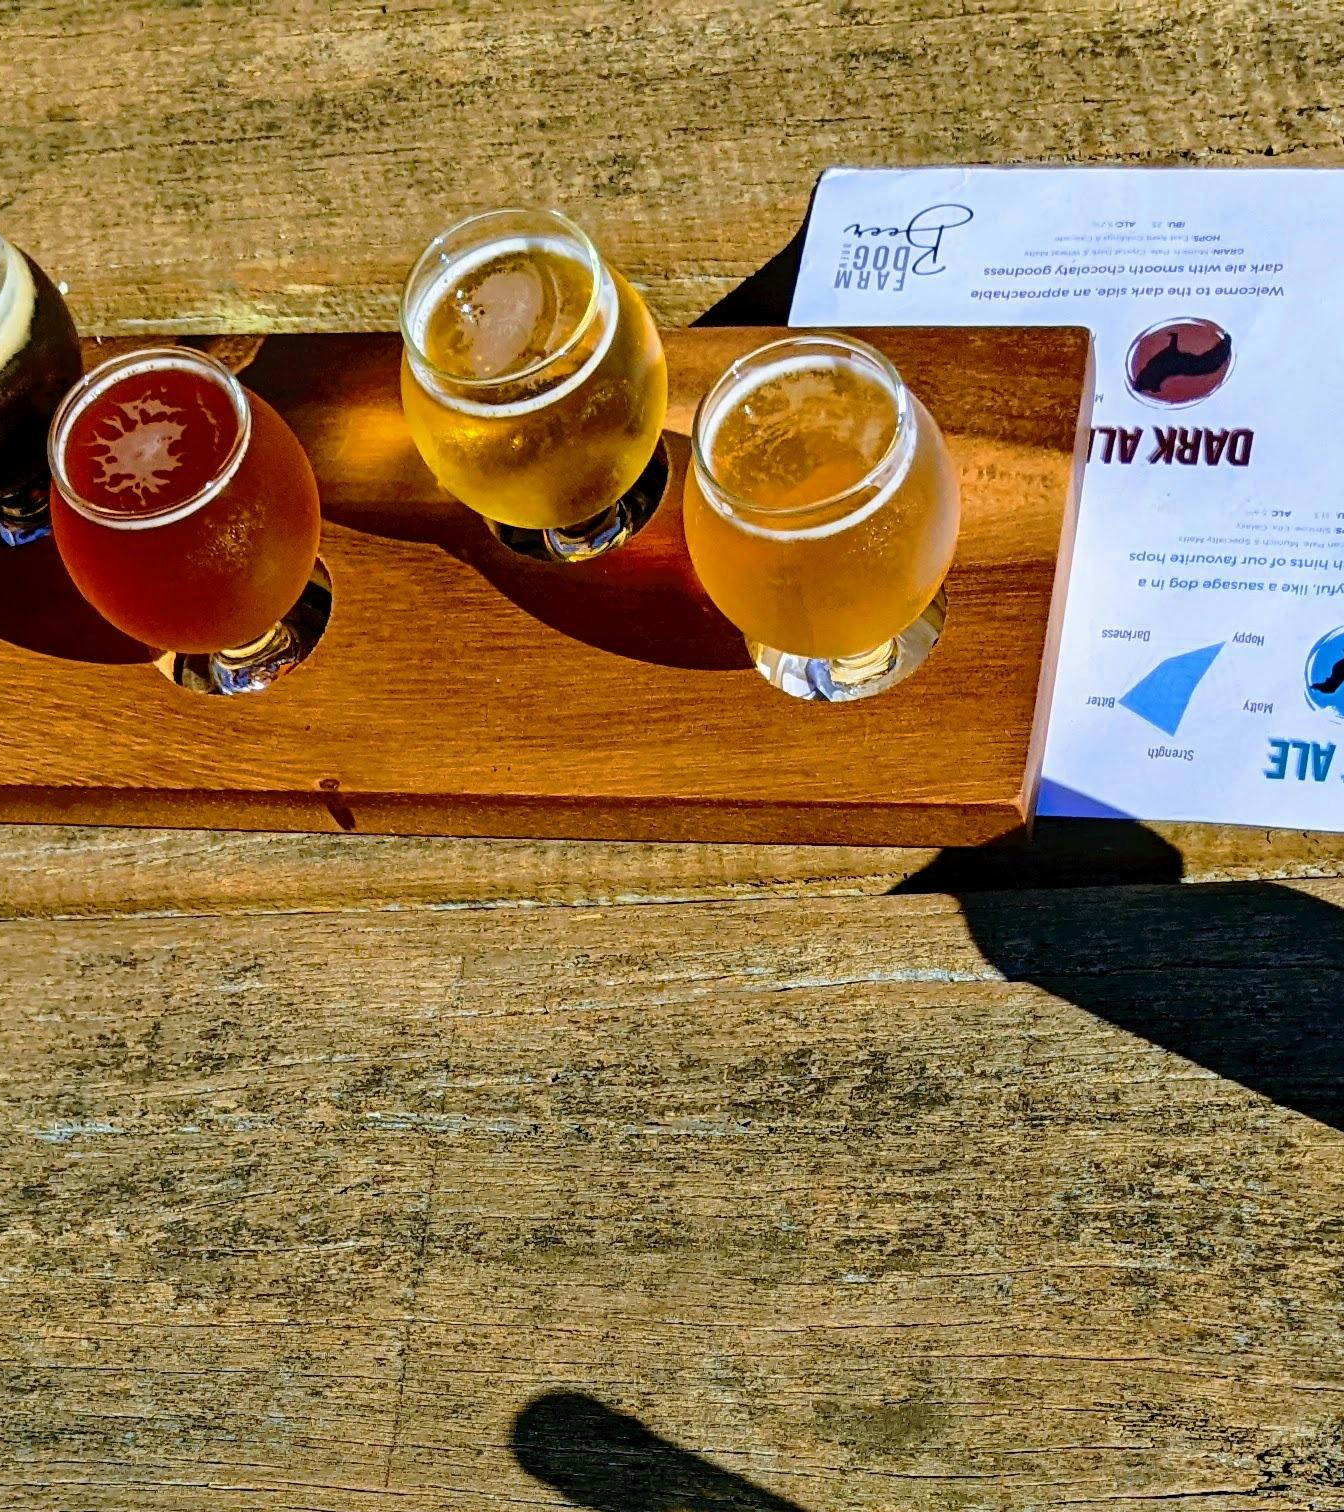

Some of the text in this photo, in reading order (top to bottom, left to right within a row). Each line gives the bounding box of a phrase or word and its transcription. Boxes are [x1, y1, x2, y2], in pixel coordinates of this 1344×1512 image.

[842, 203, 974, 276] Beer
[851, 244, 910, 272] DOG
[983, 262, 1283, 277] dark ale with smooth chocolaty goodness
[832, 269, 906, 292] FARM
[969, 285, 1285, 301] Welcome to the dark side, an approachable
[1146, 425, 1254, 467] DARK
[1128, 549, 1166, 565] hops
[1169, 552, 1237, 567] favourite
[1240, 555, 1267, 566] our
[1268, 556, 1287, 570] of
[1289, 557, 1328, 571] hints
[1137, 577, 1147, 588] a
[1149, 578, 1165, 590] in
[1168, 576, 1199, 591] dog
[1201, 576, 1265, 591] sausage
[1267, 581, 1278, 592] a
[1280, 582, 1309, 596] like
[1100, 627, 1151, 643] Darkness
[1231, 630, 1265, 646] Hoppy
[1084, 694, 1116, 708] Bitter
[1241, 698, 1274, 714] Malty
[1146, 745, 1194, 762] Strength
[1263, 738, 1337, 782] ALE
